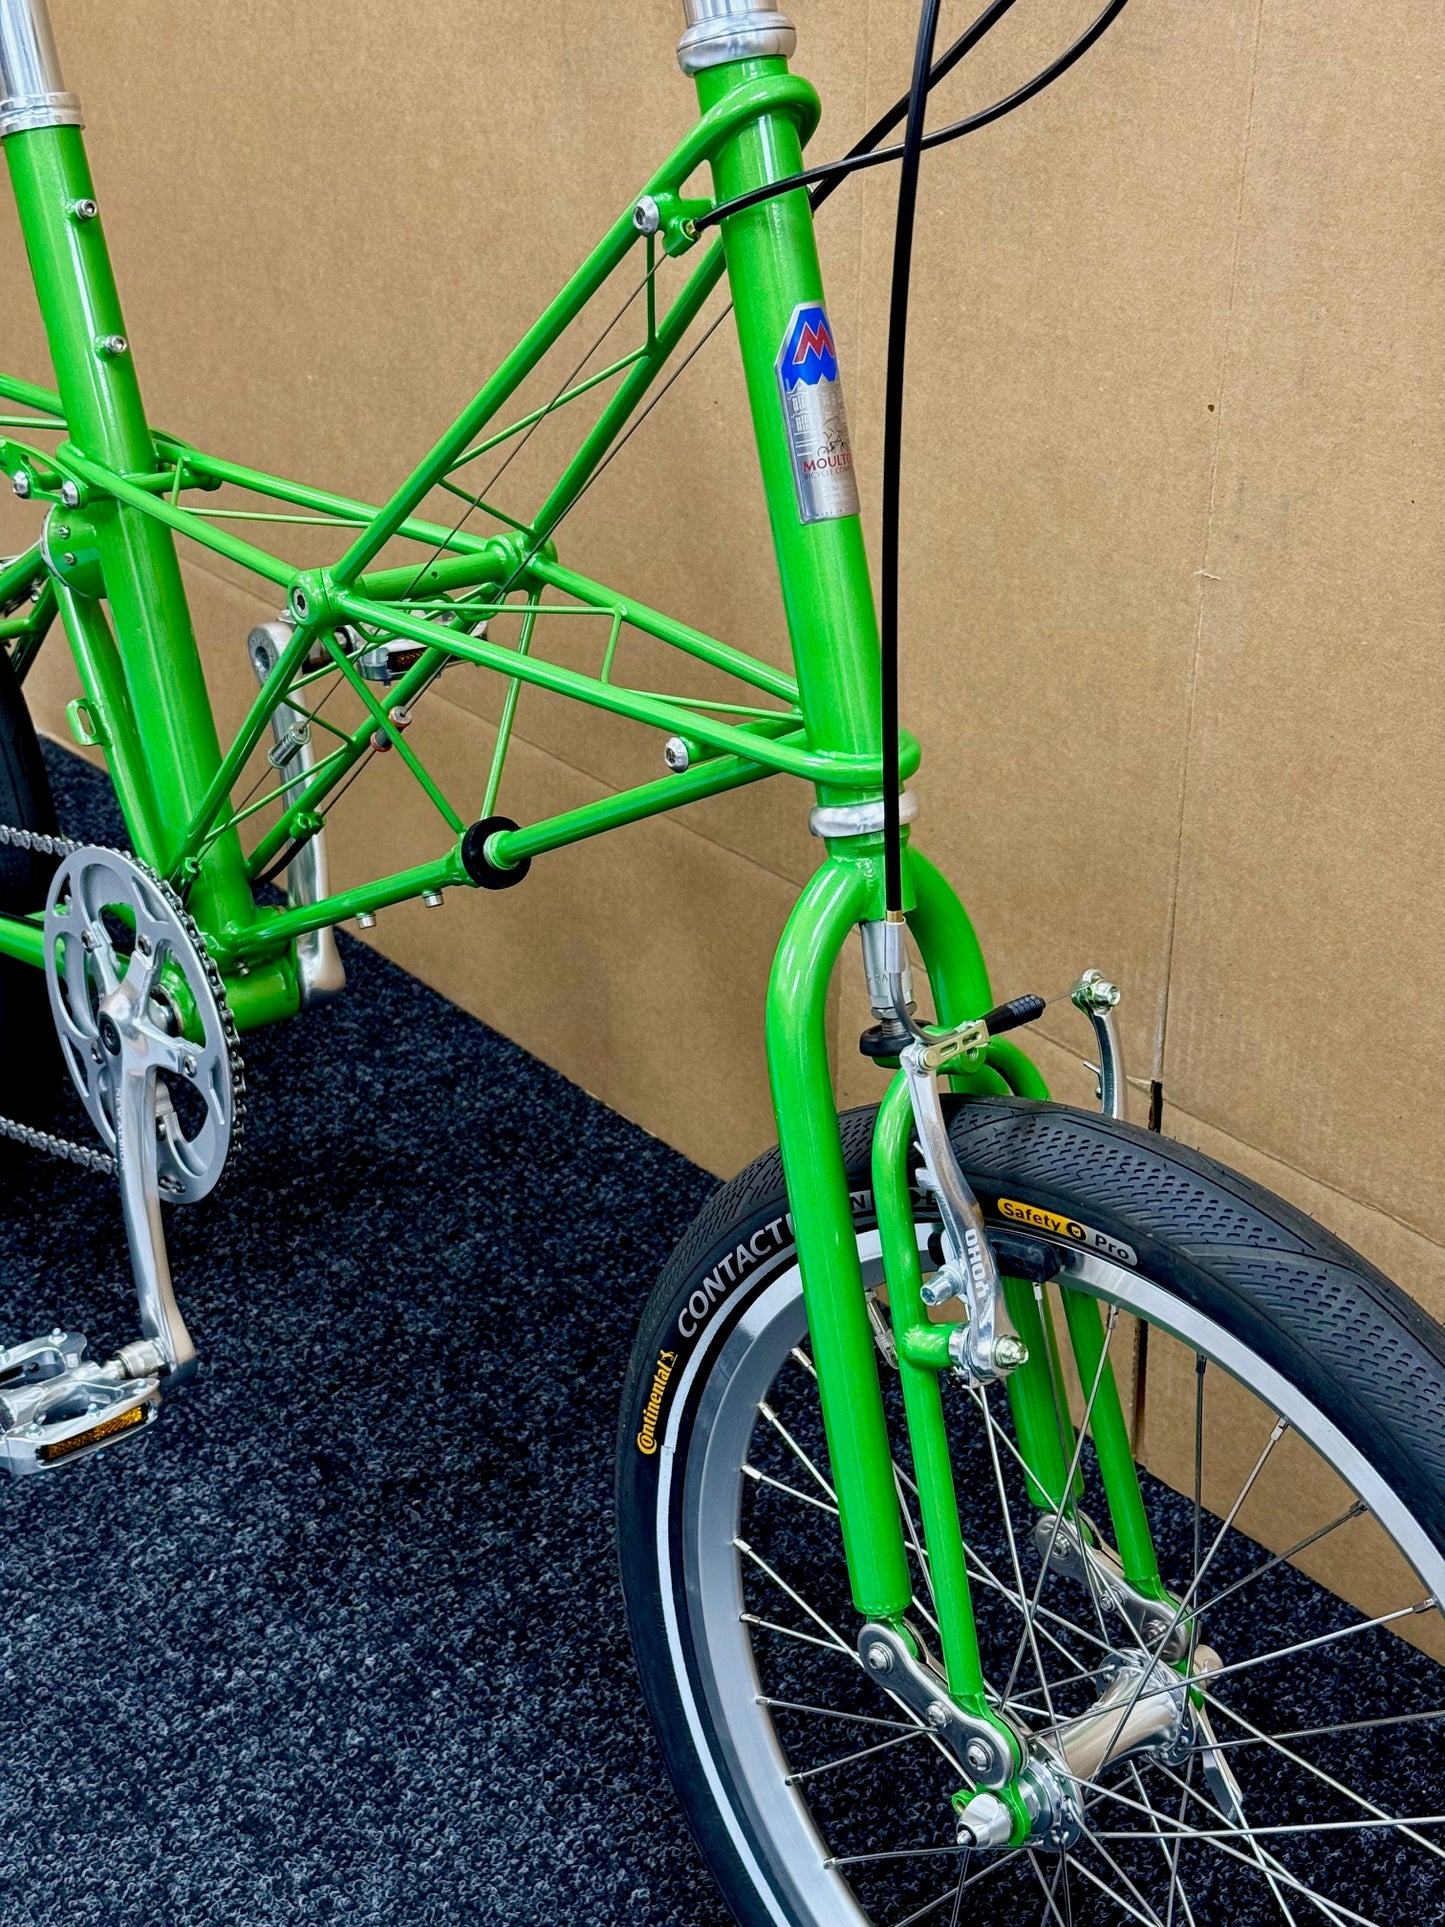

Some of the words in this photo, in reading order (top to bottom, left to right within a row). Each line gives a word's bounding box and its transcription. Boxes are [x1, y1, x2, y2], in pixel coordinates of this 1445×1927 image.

[792, 320, 836, 365] M
[803, 453, 853, 472] MOULTO
[804, 469, 834, 480] BICYCLE
[1003, 1203, 1061, 1232] Safety
[1095, 1234, 1129, 1260] Pro
[678, 1217, 783, 1338] CONTACT
[637, 1358, 673, 1455] Continental
